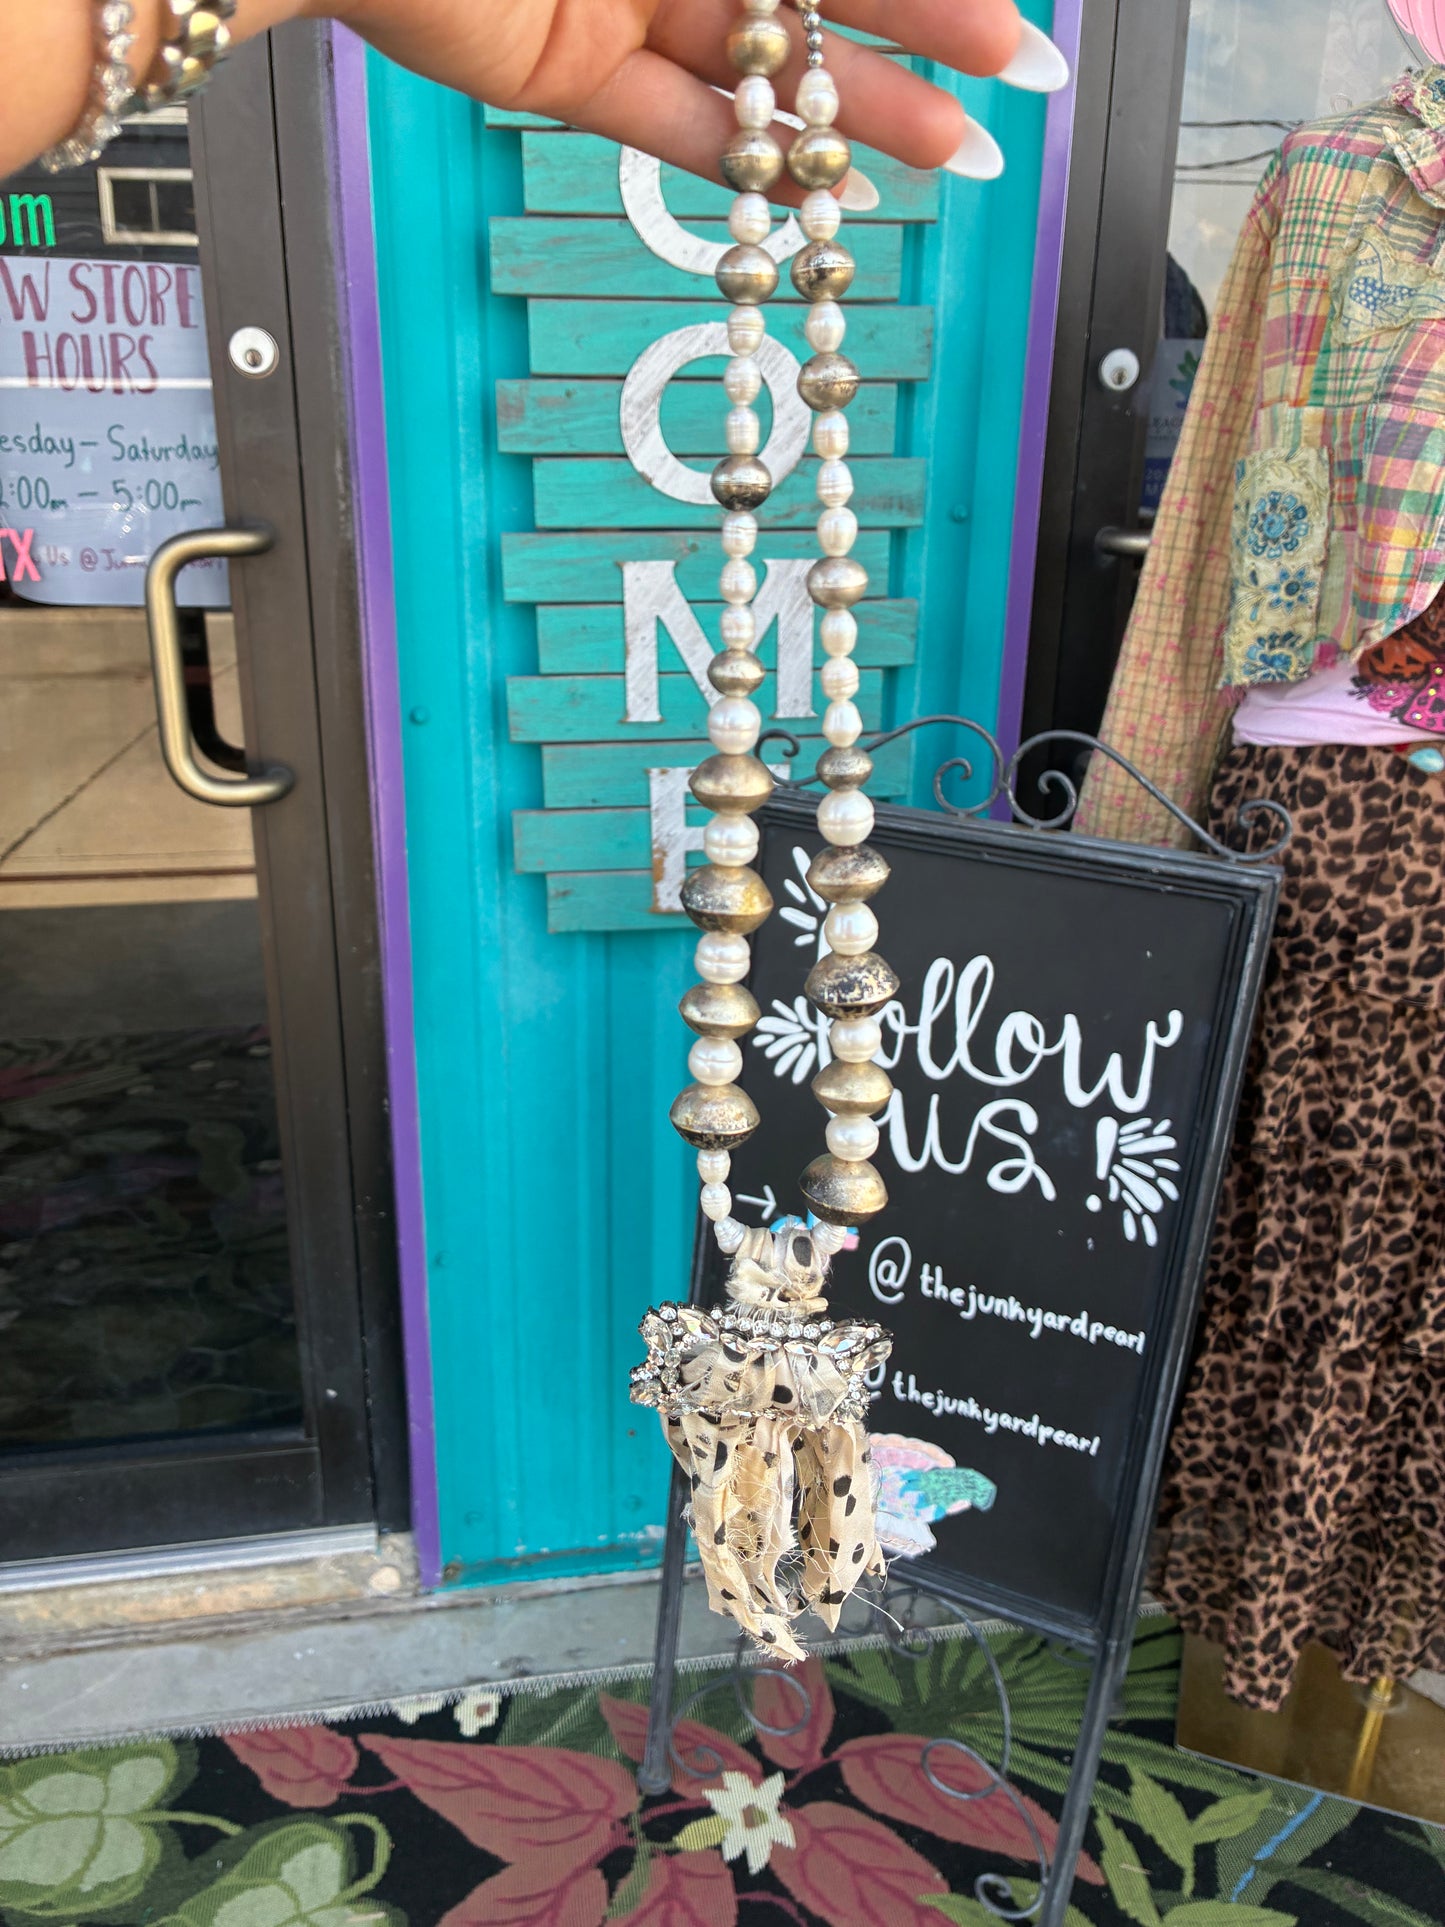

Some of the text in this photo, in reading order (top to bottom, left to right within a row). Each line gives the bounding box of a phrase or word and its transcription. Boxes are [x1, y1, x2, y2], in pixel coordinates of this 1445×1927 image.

[68, 261, 200, 329] STORE
[22, 330, 159, 395] HOURS
[107, 423, 220, 470] Saturday
[816, 902, 1184, 1114] ollow
